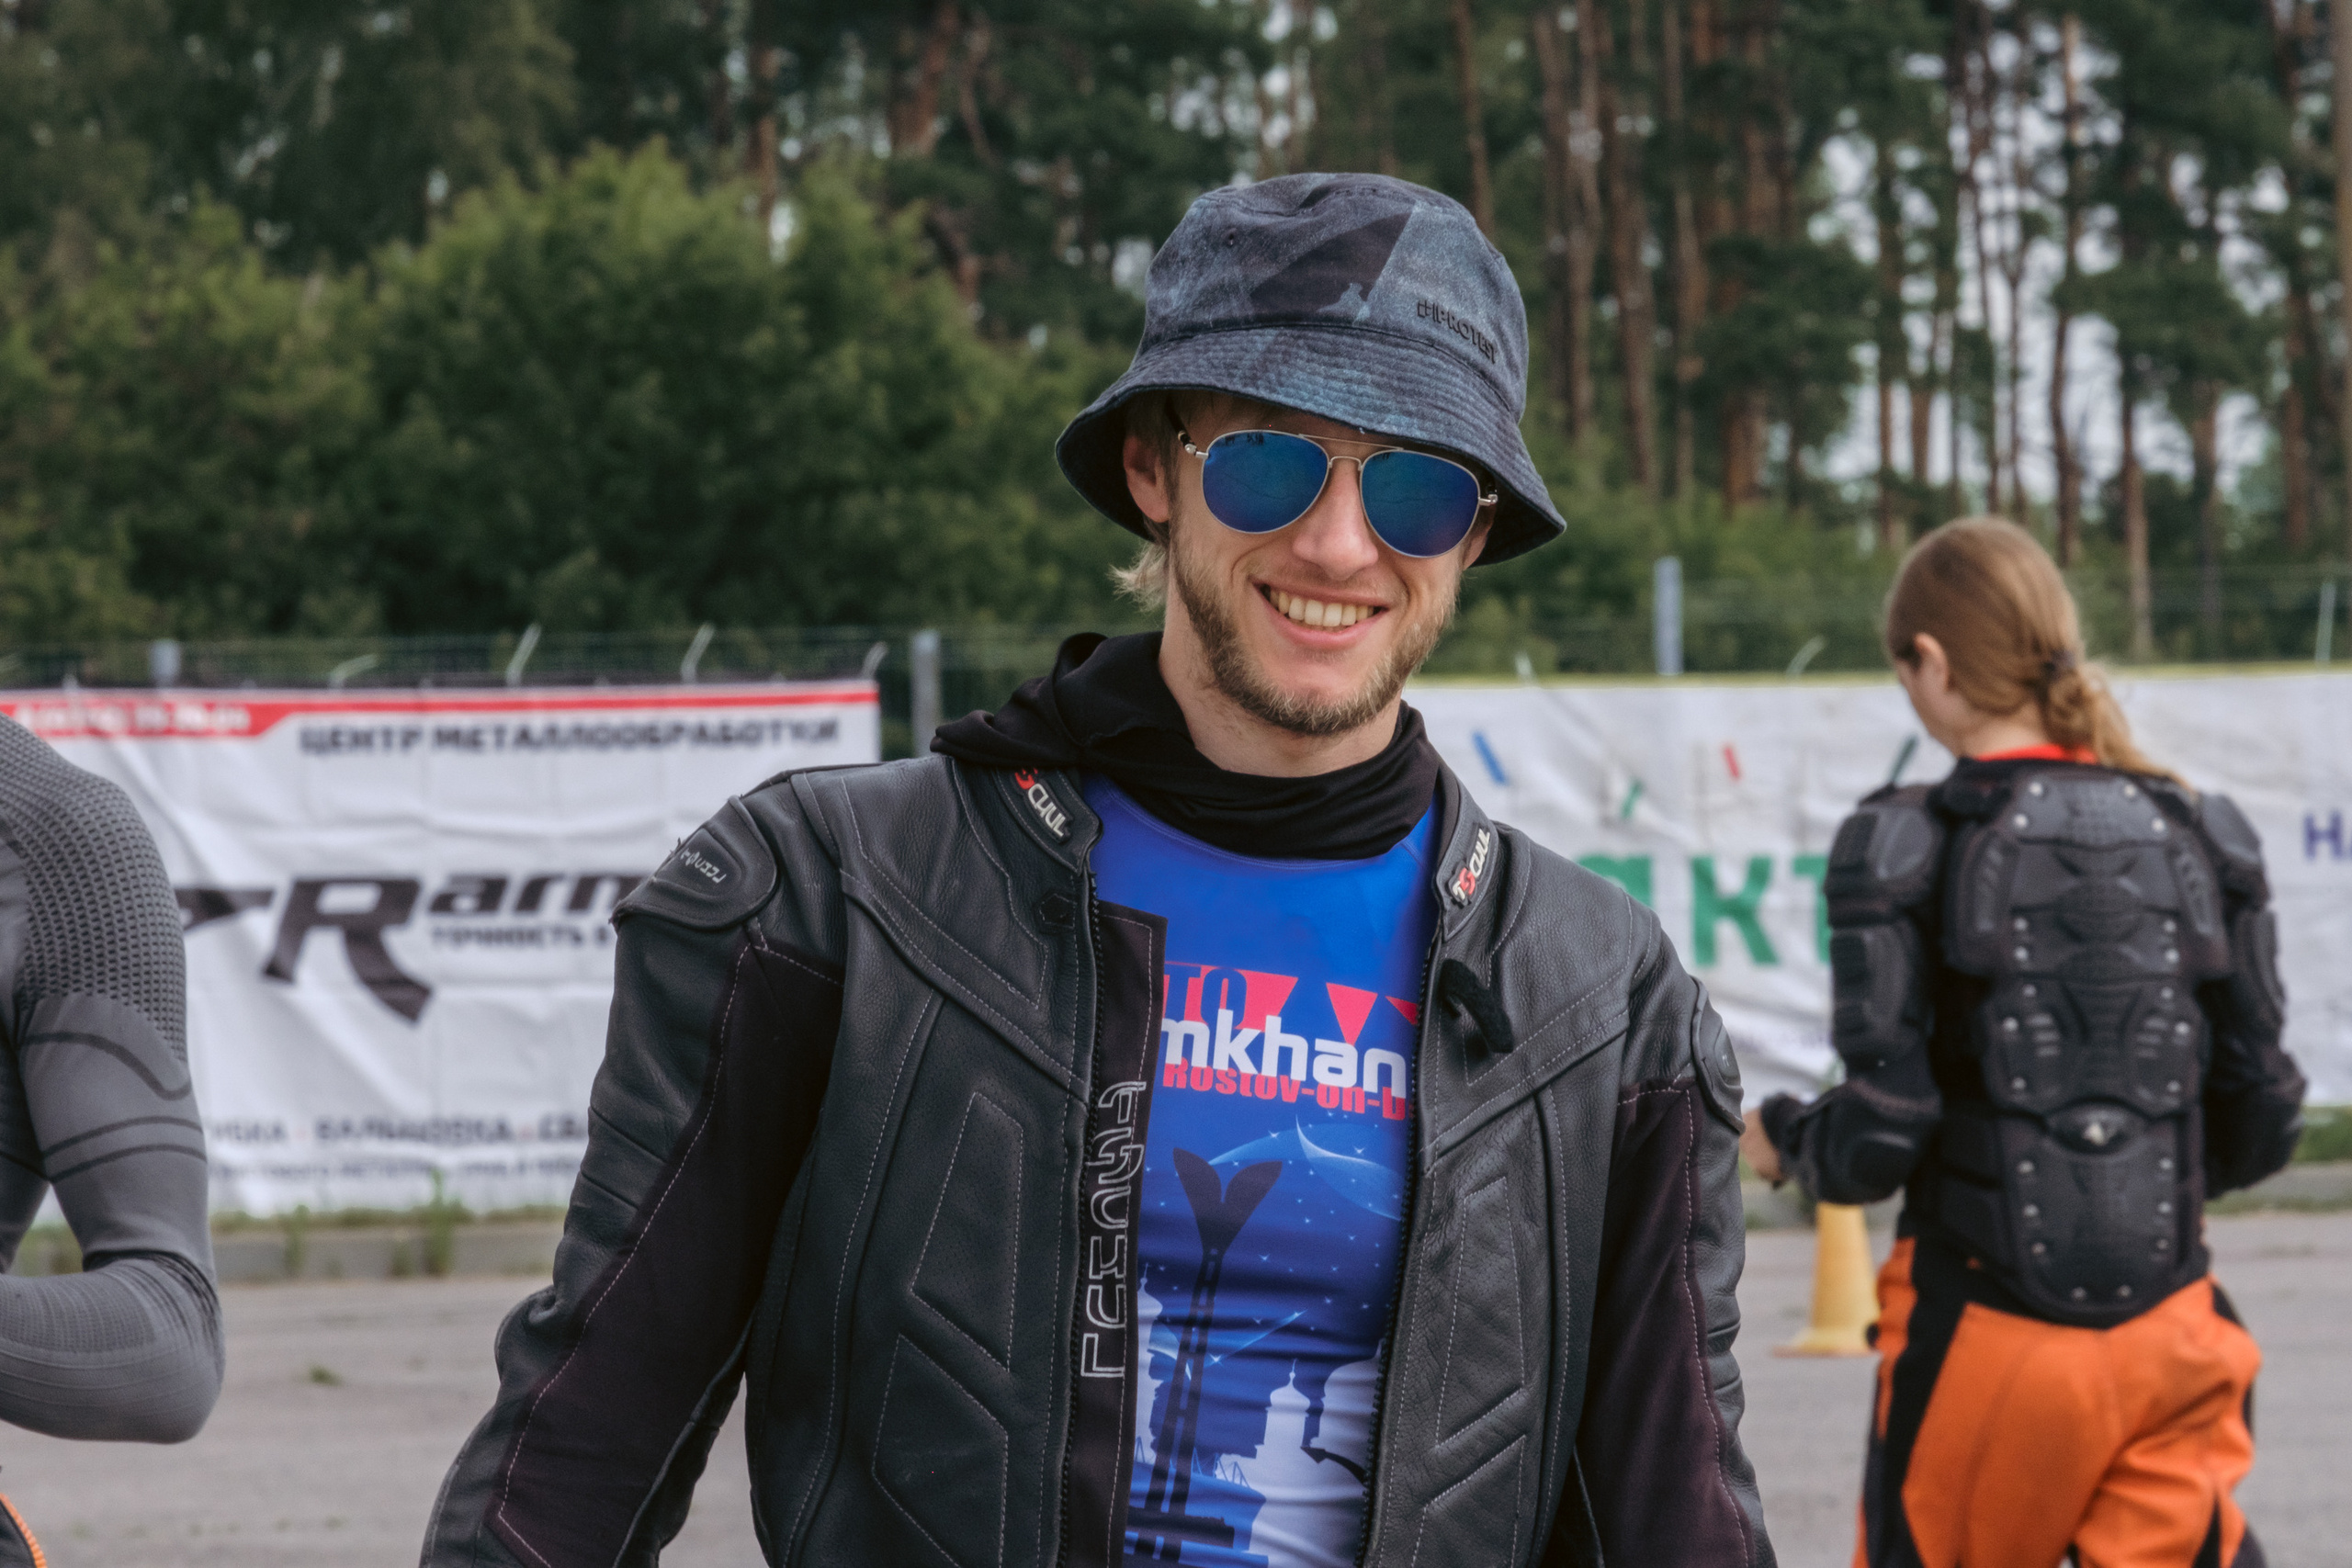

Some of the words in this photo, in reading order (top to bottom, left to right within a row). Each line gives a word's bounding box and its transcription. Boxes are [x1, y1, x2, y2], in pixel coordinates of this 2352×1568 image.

[300, 724, 424, 754] ЦЕНТР
[1160, 1008, 1407, 1100] mkhan
[1162, 1056, 1415, 1122] Rostov-on-D
